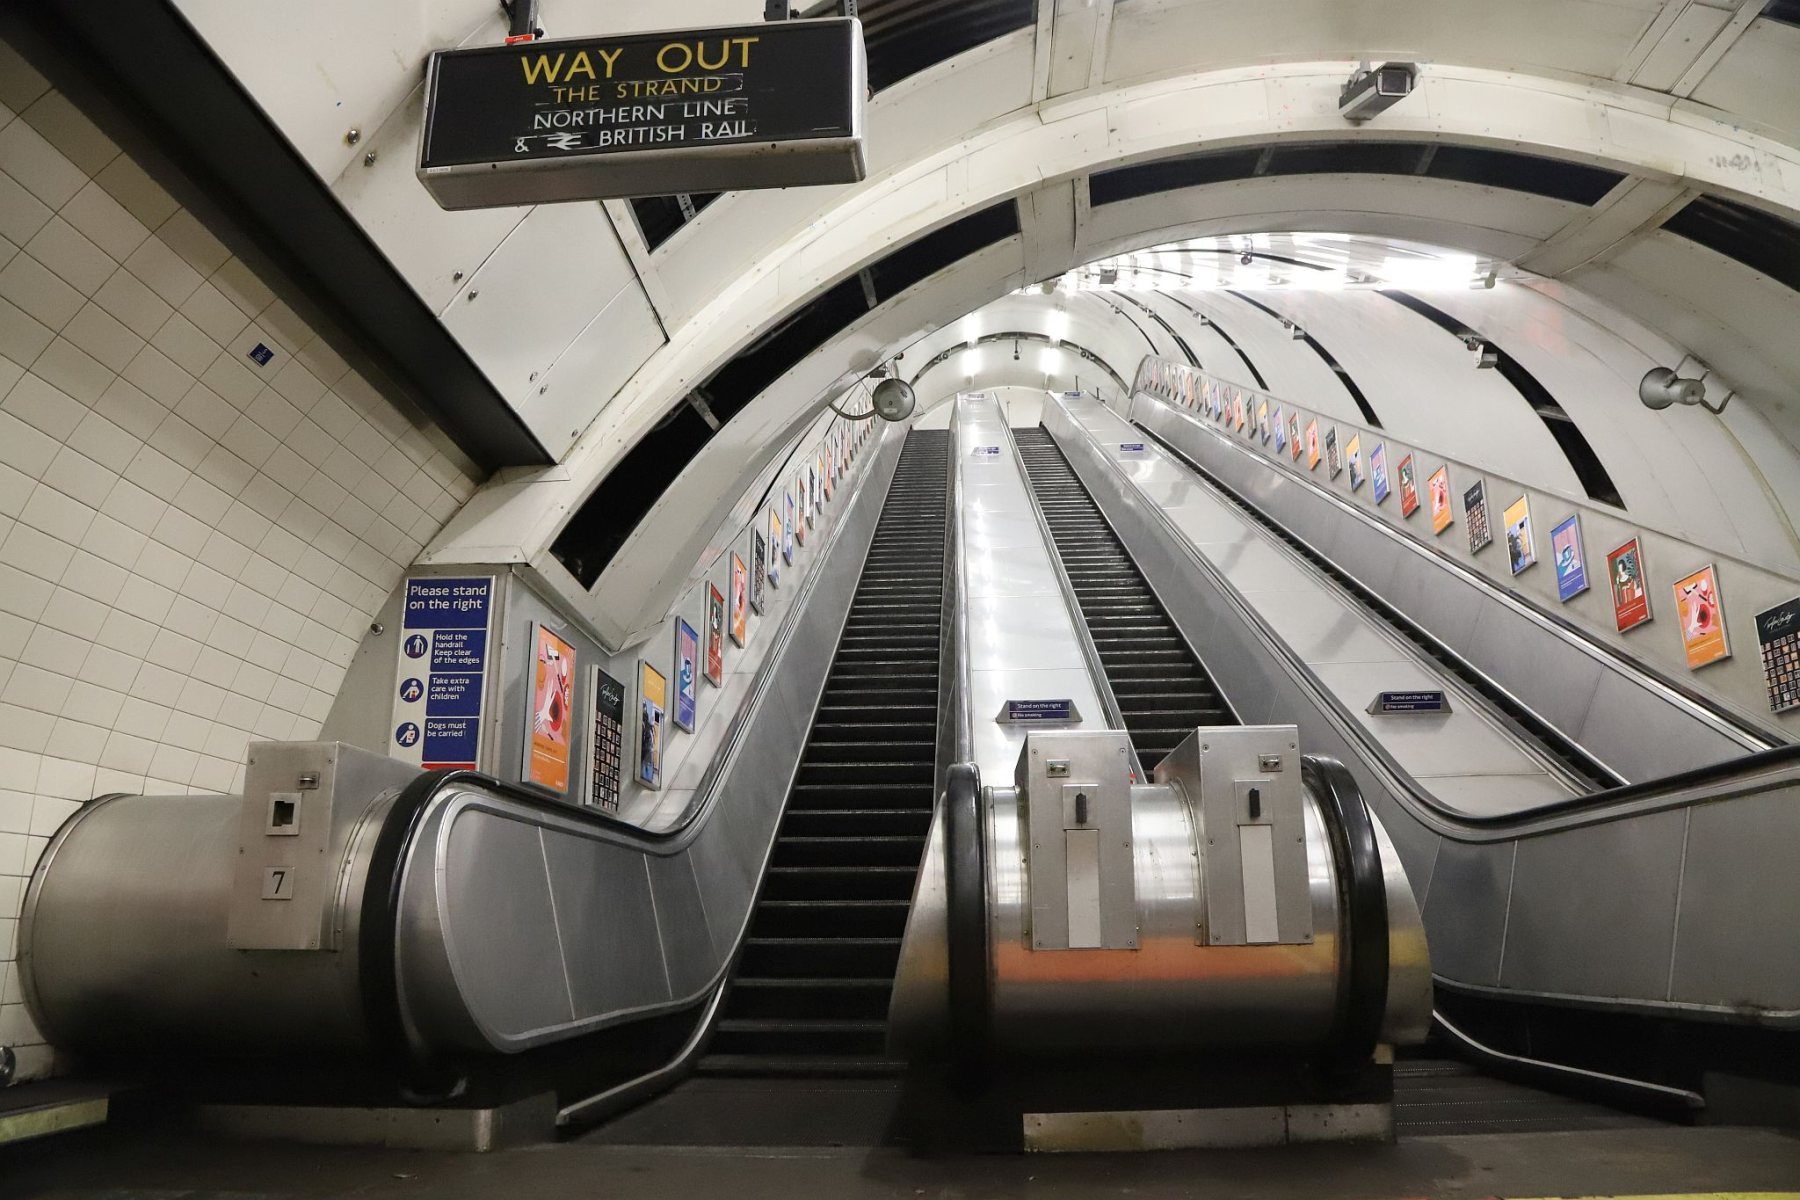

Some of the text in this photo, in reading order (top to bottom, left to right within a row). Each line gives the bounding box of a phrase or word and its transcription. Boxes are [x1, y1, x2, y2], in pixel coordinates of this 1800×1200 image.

[521, 37, 760, 85] WAY OUT
[553, 78, 721, 103] THE STRAND
[533, 98, 738, 130] NORTHERN LINE
[514, 120, 754, 153] & BRITISH RAIL
[410, 585, 487, 596] Please stand
[409, 598, 483, 612] on the right
[434, 649, 453, 658] Keep
[458, 657, 480, 665] edges
[427, 722, 447, 730] Dogs
[271, 870, 286, 895] 7
